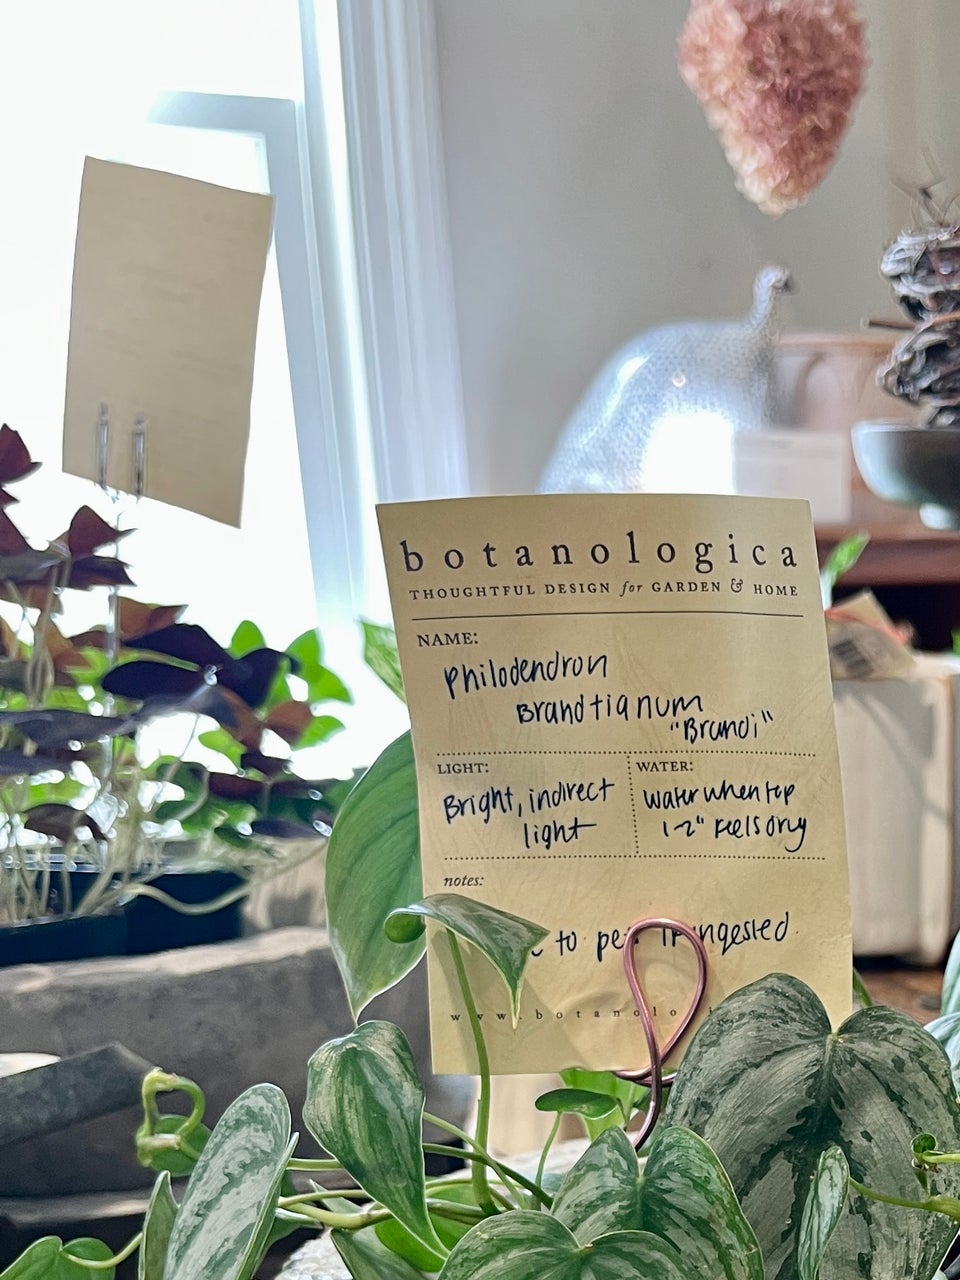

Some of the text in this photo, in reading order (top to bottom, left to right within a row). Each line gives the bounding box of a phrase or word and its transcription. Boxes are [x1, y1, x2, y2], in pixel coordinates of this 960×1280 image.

[400, 531, 798, 575] botanologica
[409, 578, 798, 601] THOUGHTFUL DESIGN for GARDEN & HOME
[417, 632, 479, 647] NAME:
[437, 763, 490, 775] LIGHT:
[636, 761, 694, 773] WATER:
[528, 777, 616, 813] indirect
[703, 780, 761, 803] when
[765, 780, 795, 806] top
[523, 817, 598, 850] light
[765, 815, 808, 853] dry
[443, 874, 485, 887] notes:
[555, 930, 578, 957] to
